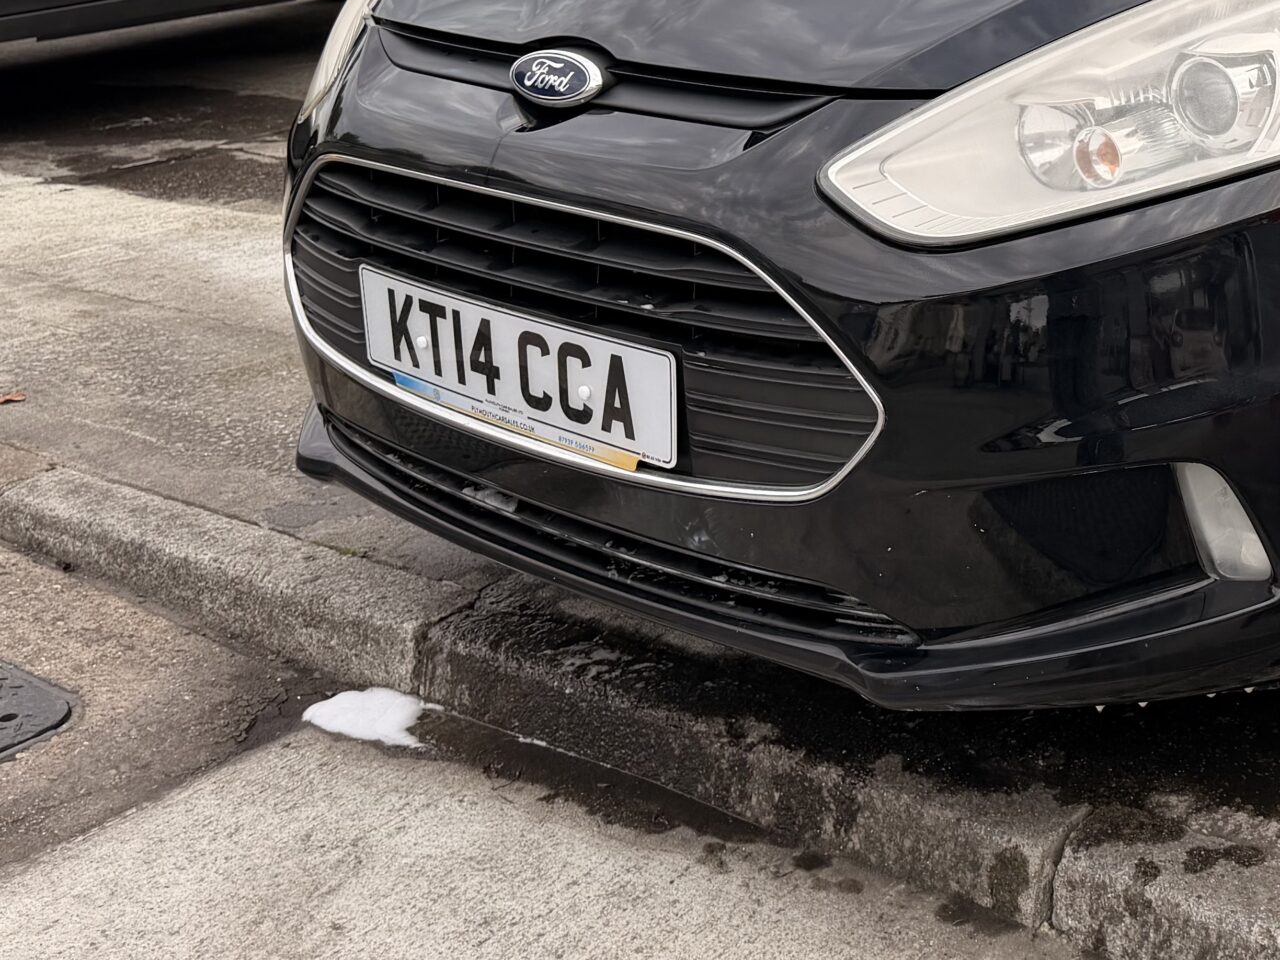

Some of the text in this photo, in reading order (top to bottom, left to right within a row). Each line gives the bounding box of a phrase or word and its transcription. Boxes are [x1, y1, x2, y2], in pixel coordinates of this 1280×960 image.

[523, 58, 575, 93] Ford
[387, 288, 636, 441] KT14 CCA
